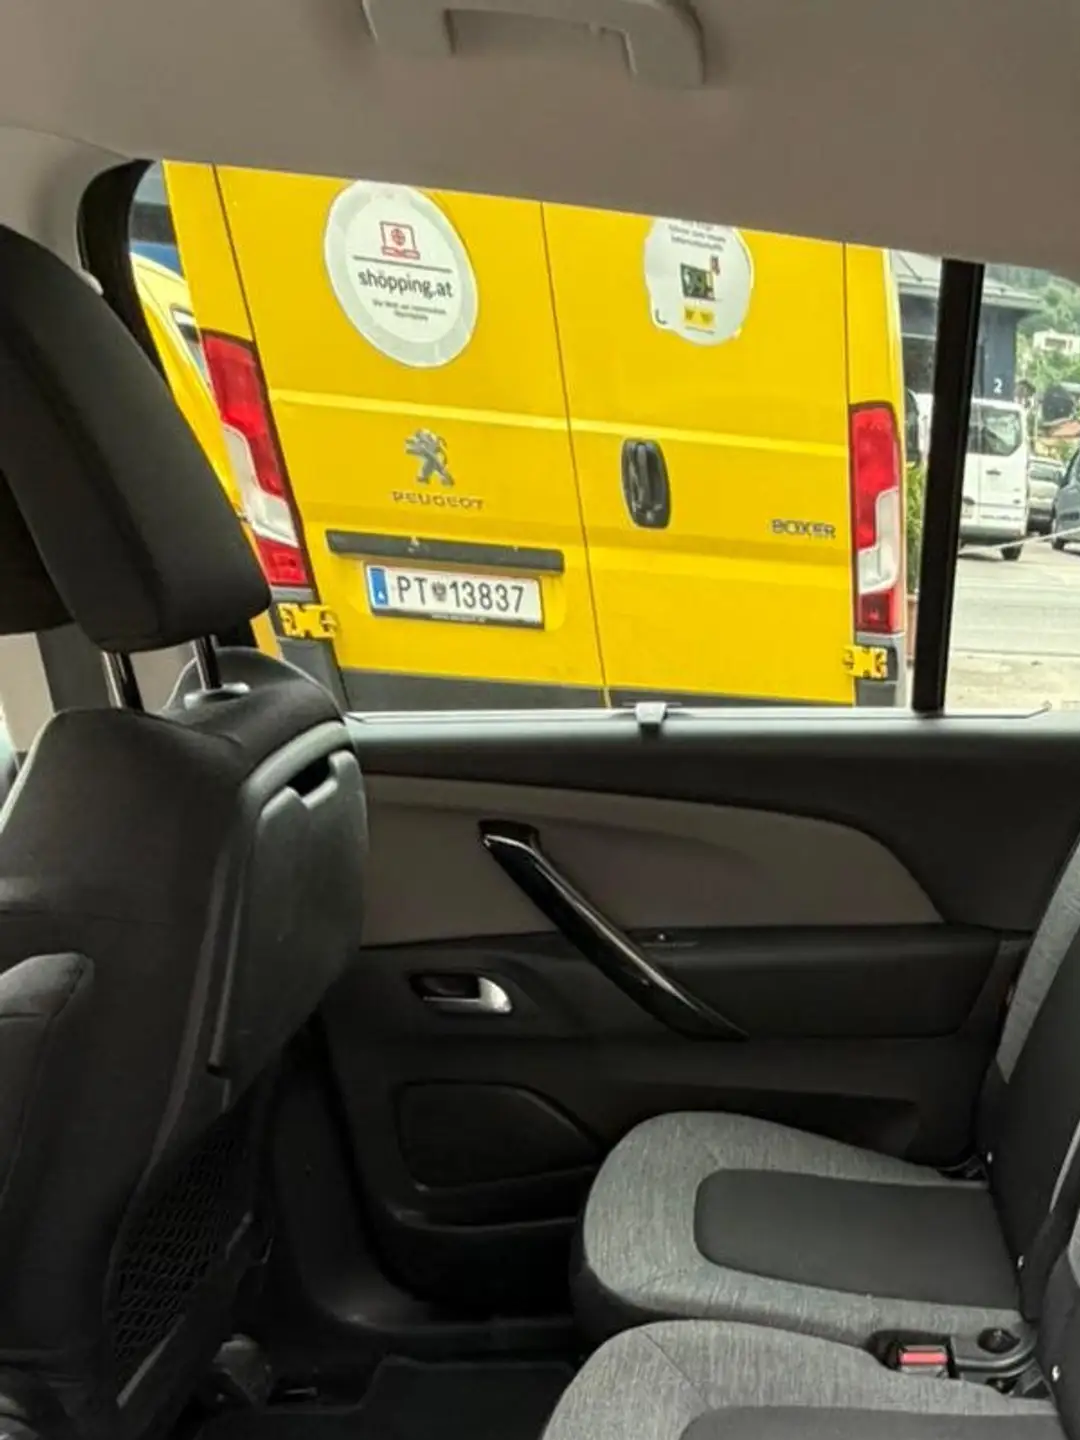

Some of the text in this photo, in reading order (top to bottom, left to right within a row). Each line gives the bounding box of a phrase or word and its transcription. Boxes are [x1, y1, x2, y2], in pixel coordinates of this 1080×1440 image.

[993, 377, 1003, 394] 2
[392, 490, 484, 511] PEUGEOT
[771, 518, 836, 539] BOXER
[396, 575, 525, 613] PT 13837
